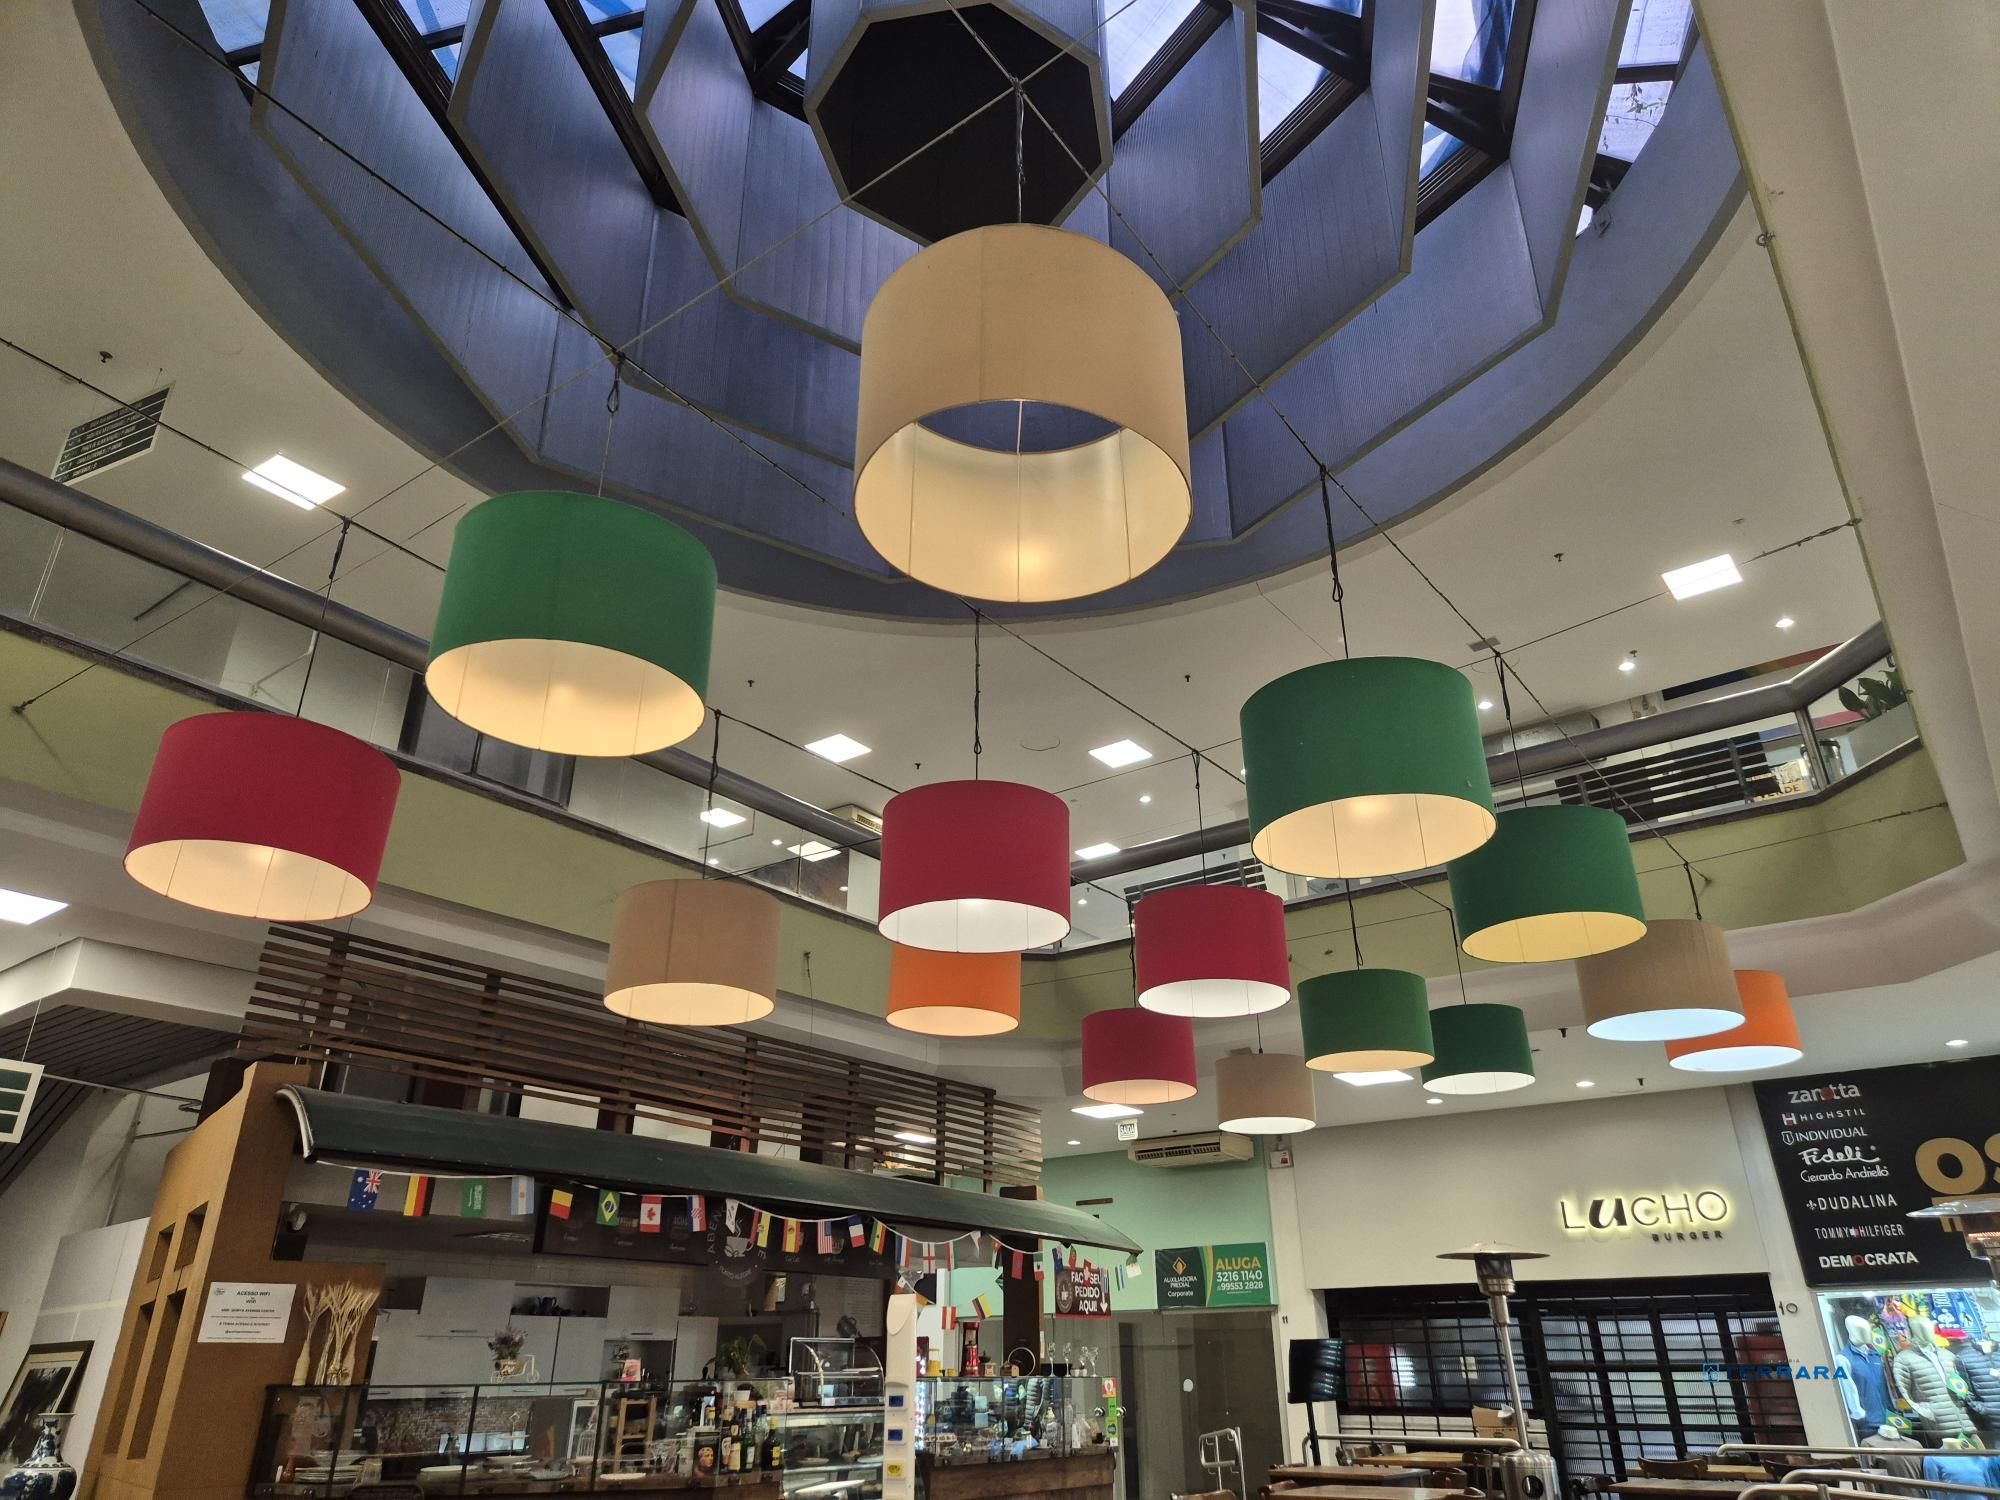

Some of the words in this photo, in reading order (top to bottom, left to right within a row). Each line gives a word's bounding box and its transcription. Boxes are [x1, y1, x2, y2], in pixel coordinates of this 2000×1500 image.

[1800, 1108, 1867, 1122] HIGHSTIL
[1796, 1126, 1868, 1142] INDIVIDUAL
[1801, 1168, 1842, 1183] Gerardo
[1817, 1193, 1898, 1211] DUDALINA
[1652, 1230, 1723, 1242] BURGER
[1815, 1226, 1850, 1240] TOMMY
[1858, 1223, 1905, 1237] HILFIGER
[1216, 1256, 1261, 1270] ALUGA
[1819, 1251, 1919, 1269] DEMOCRATA
[1216, 1271, 1239, 1282] 3216
[1242, 1269, 1263, 1280] 1140
[1075, 1286, 1100, 1298] PEDIDO
[1220, 1282, 1243, 1291] 99553
[1245, 1281, 1264, 1289] 2828
[1168, 1290, 1194, 1298] Corporate
[1779, 1301, 1798, 1315] 10
[1282, 1315, 1289, 1324] 11
